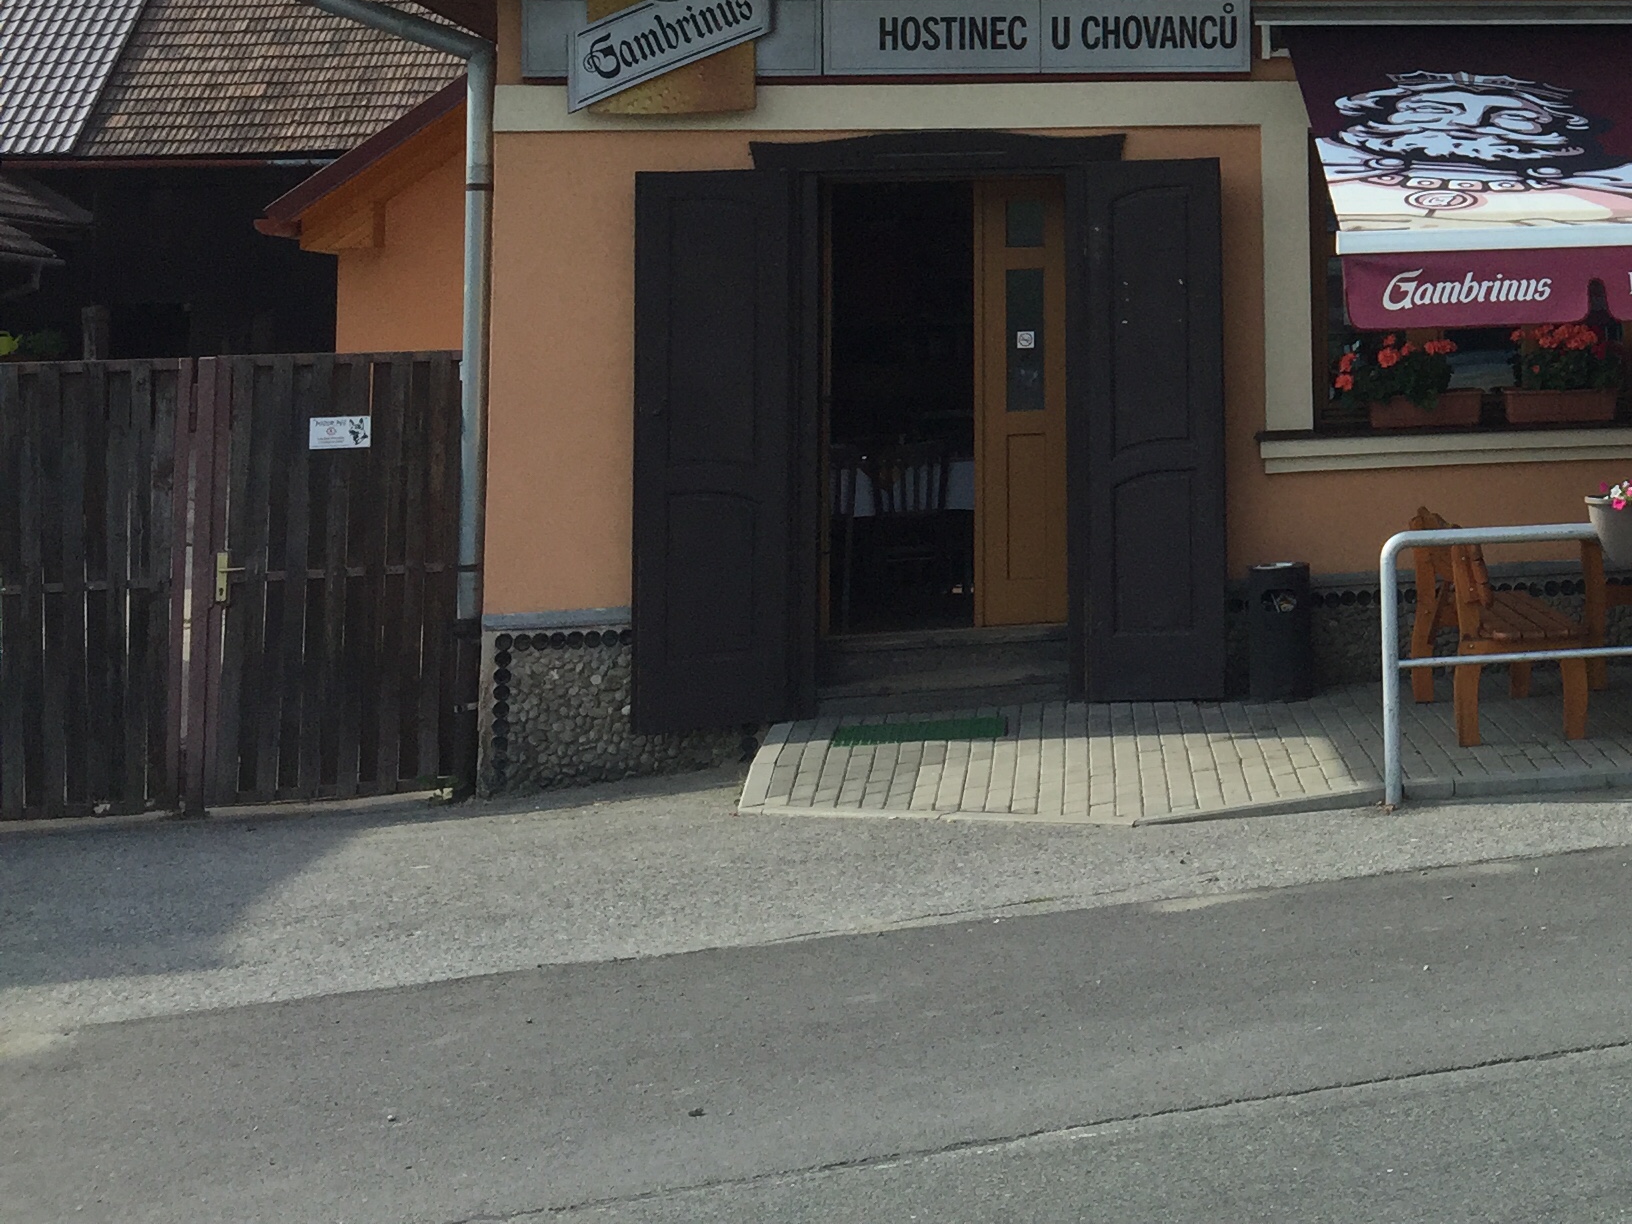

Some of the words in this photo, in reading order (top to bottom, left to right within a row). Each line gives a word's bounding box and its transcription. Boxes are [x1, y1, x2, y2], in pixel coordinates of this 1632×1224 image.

[878, 15, 1028, 51] HOSTINEC
[1051, 15, 1071, 50] U
[1081, 2, 1238, 50] CHOVANCŮ
[1382, 268, 1552, 310] Gambrinus
